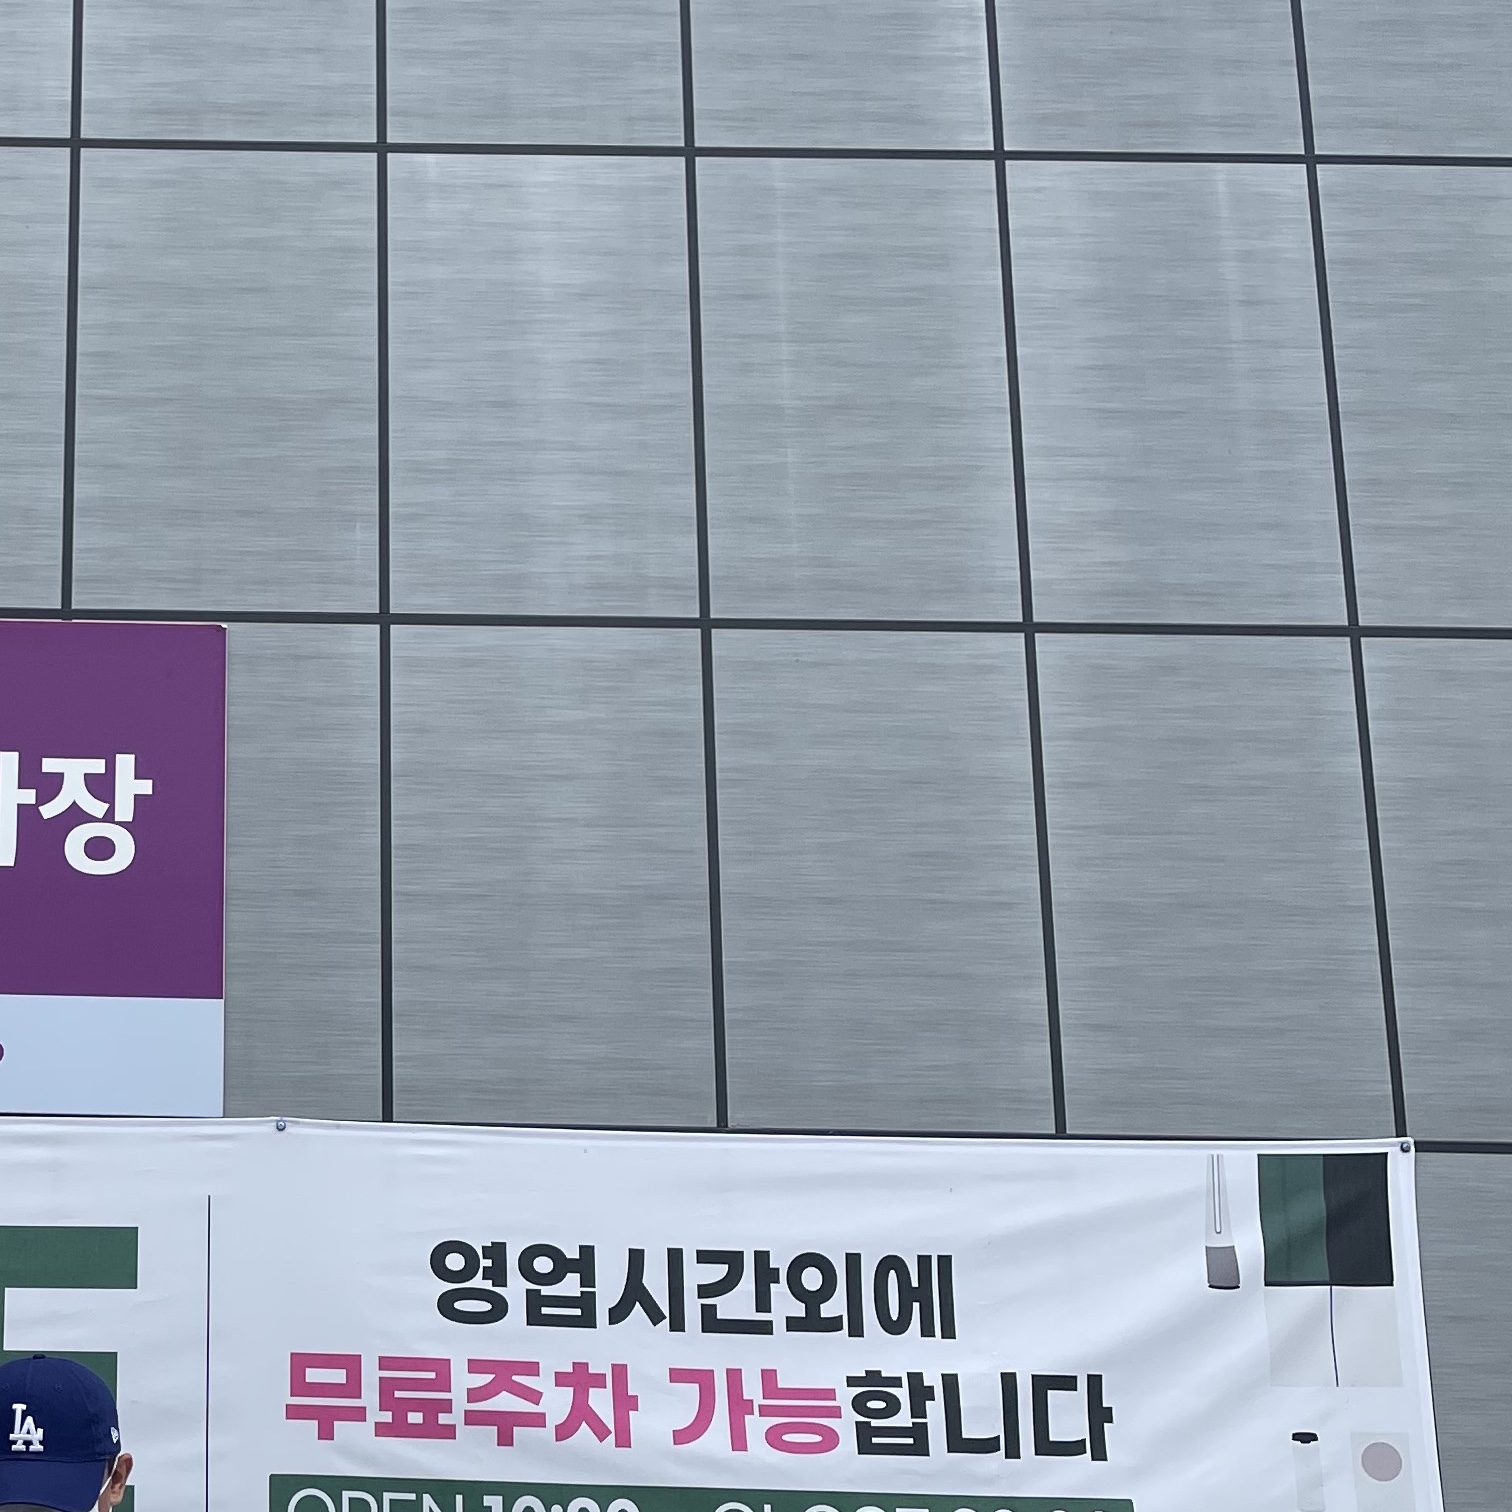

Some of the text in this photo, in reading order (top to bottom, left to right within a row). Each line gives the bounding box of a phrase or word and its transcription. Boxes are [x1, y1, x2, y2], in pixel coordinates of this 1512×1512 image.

[429, 1240, 957, 1340] 영업시간외에
[9, 1403, 44, 1452] LA
[285, 1351, 1114, 1462] 무료주차 가능합니다
